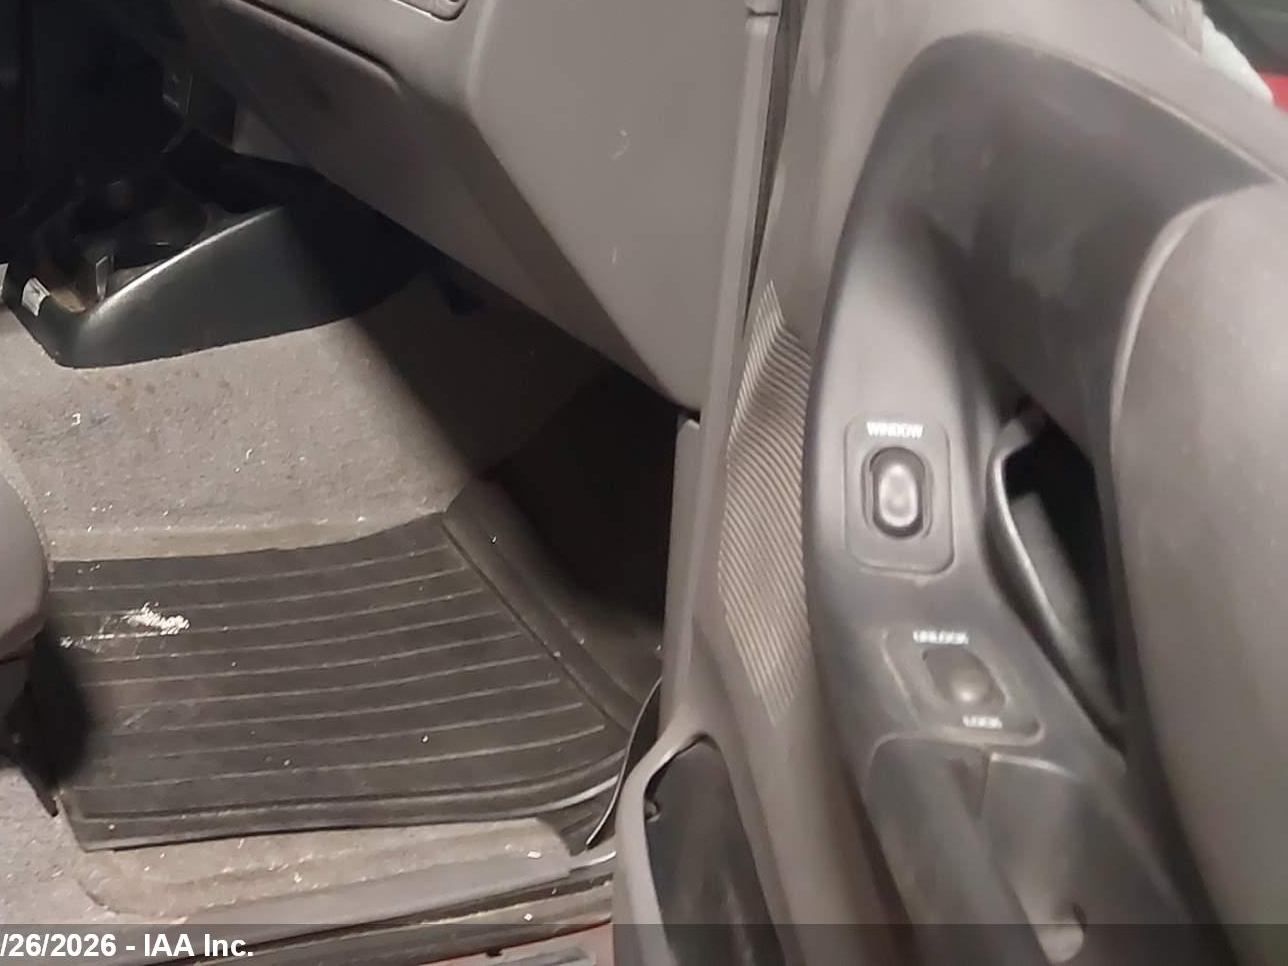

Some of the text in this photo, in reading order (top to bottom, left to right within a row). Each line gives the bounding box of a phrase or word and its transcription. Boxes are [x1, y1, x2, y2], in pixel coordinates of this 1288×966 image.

[866, 421, 924, 439] WINDOW
[913, 630, 969, 645] UNLOCK
[963, 714, 1003, 730] LOCK
